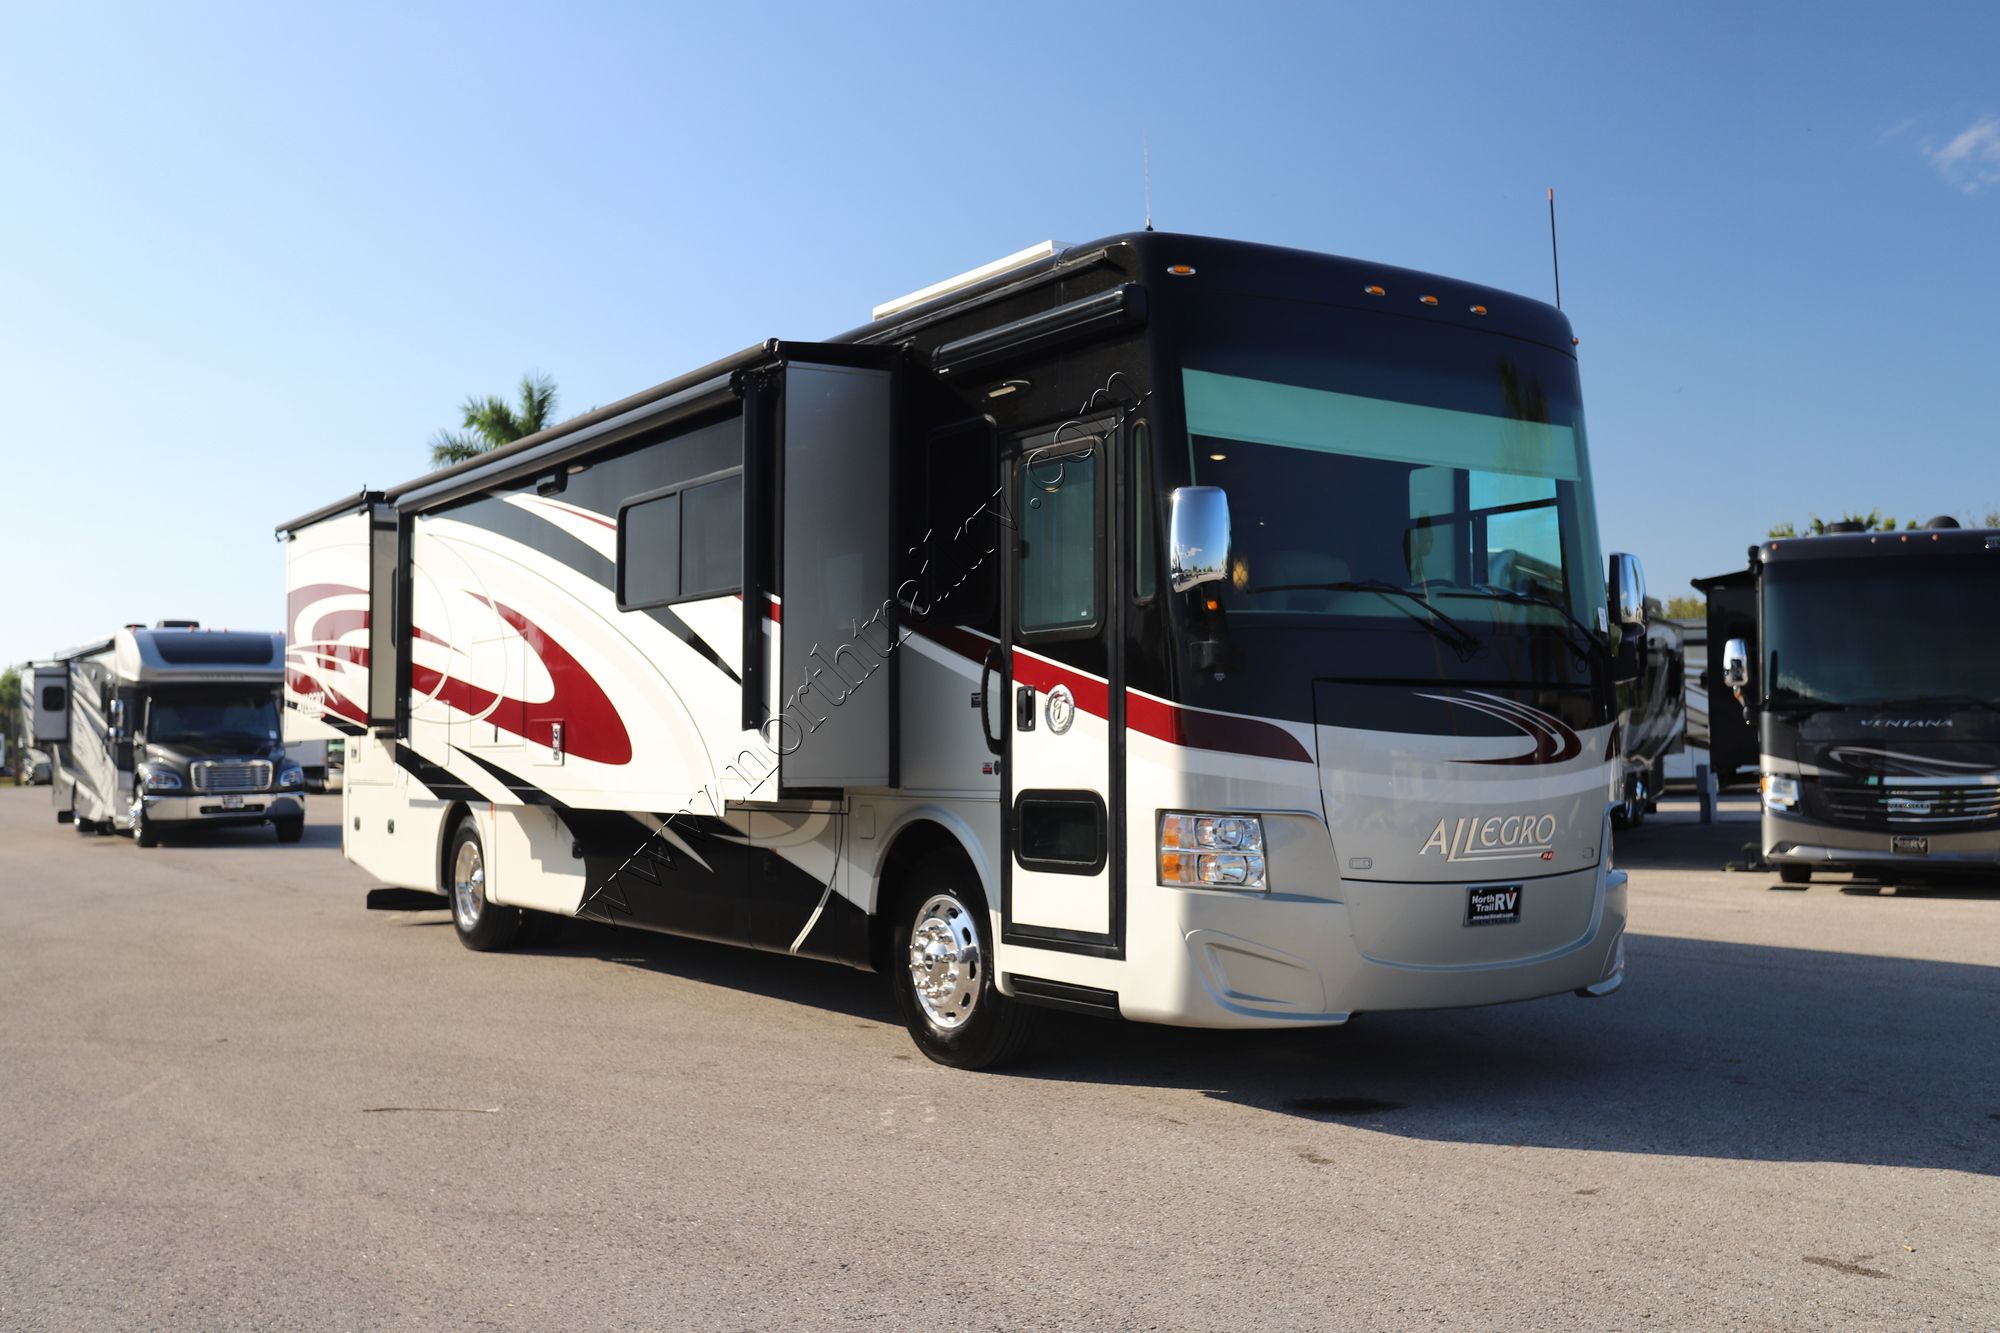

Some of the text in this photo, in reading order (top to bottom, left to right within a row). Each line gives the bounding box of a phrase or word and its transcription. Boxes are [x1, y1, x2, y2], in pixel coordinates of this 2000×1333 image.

[1860, 719, 1953, 728] VENTANA
[1418, 814, 1556, 862] ALLEGRO
[1472, 895, 1494, 904] North
[1495, 892, 1517, 911] RV
[1476, 903, 1494, 912] Trail
